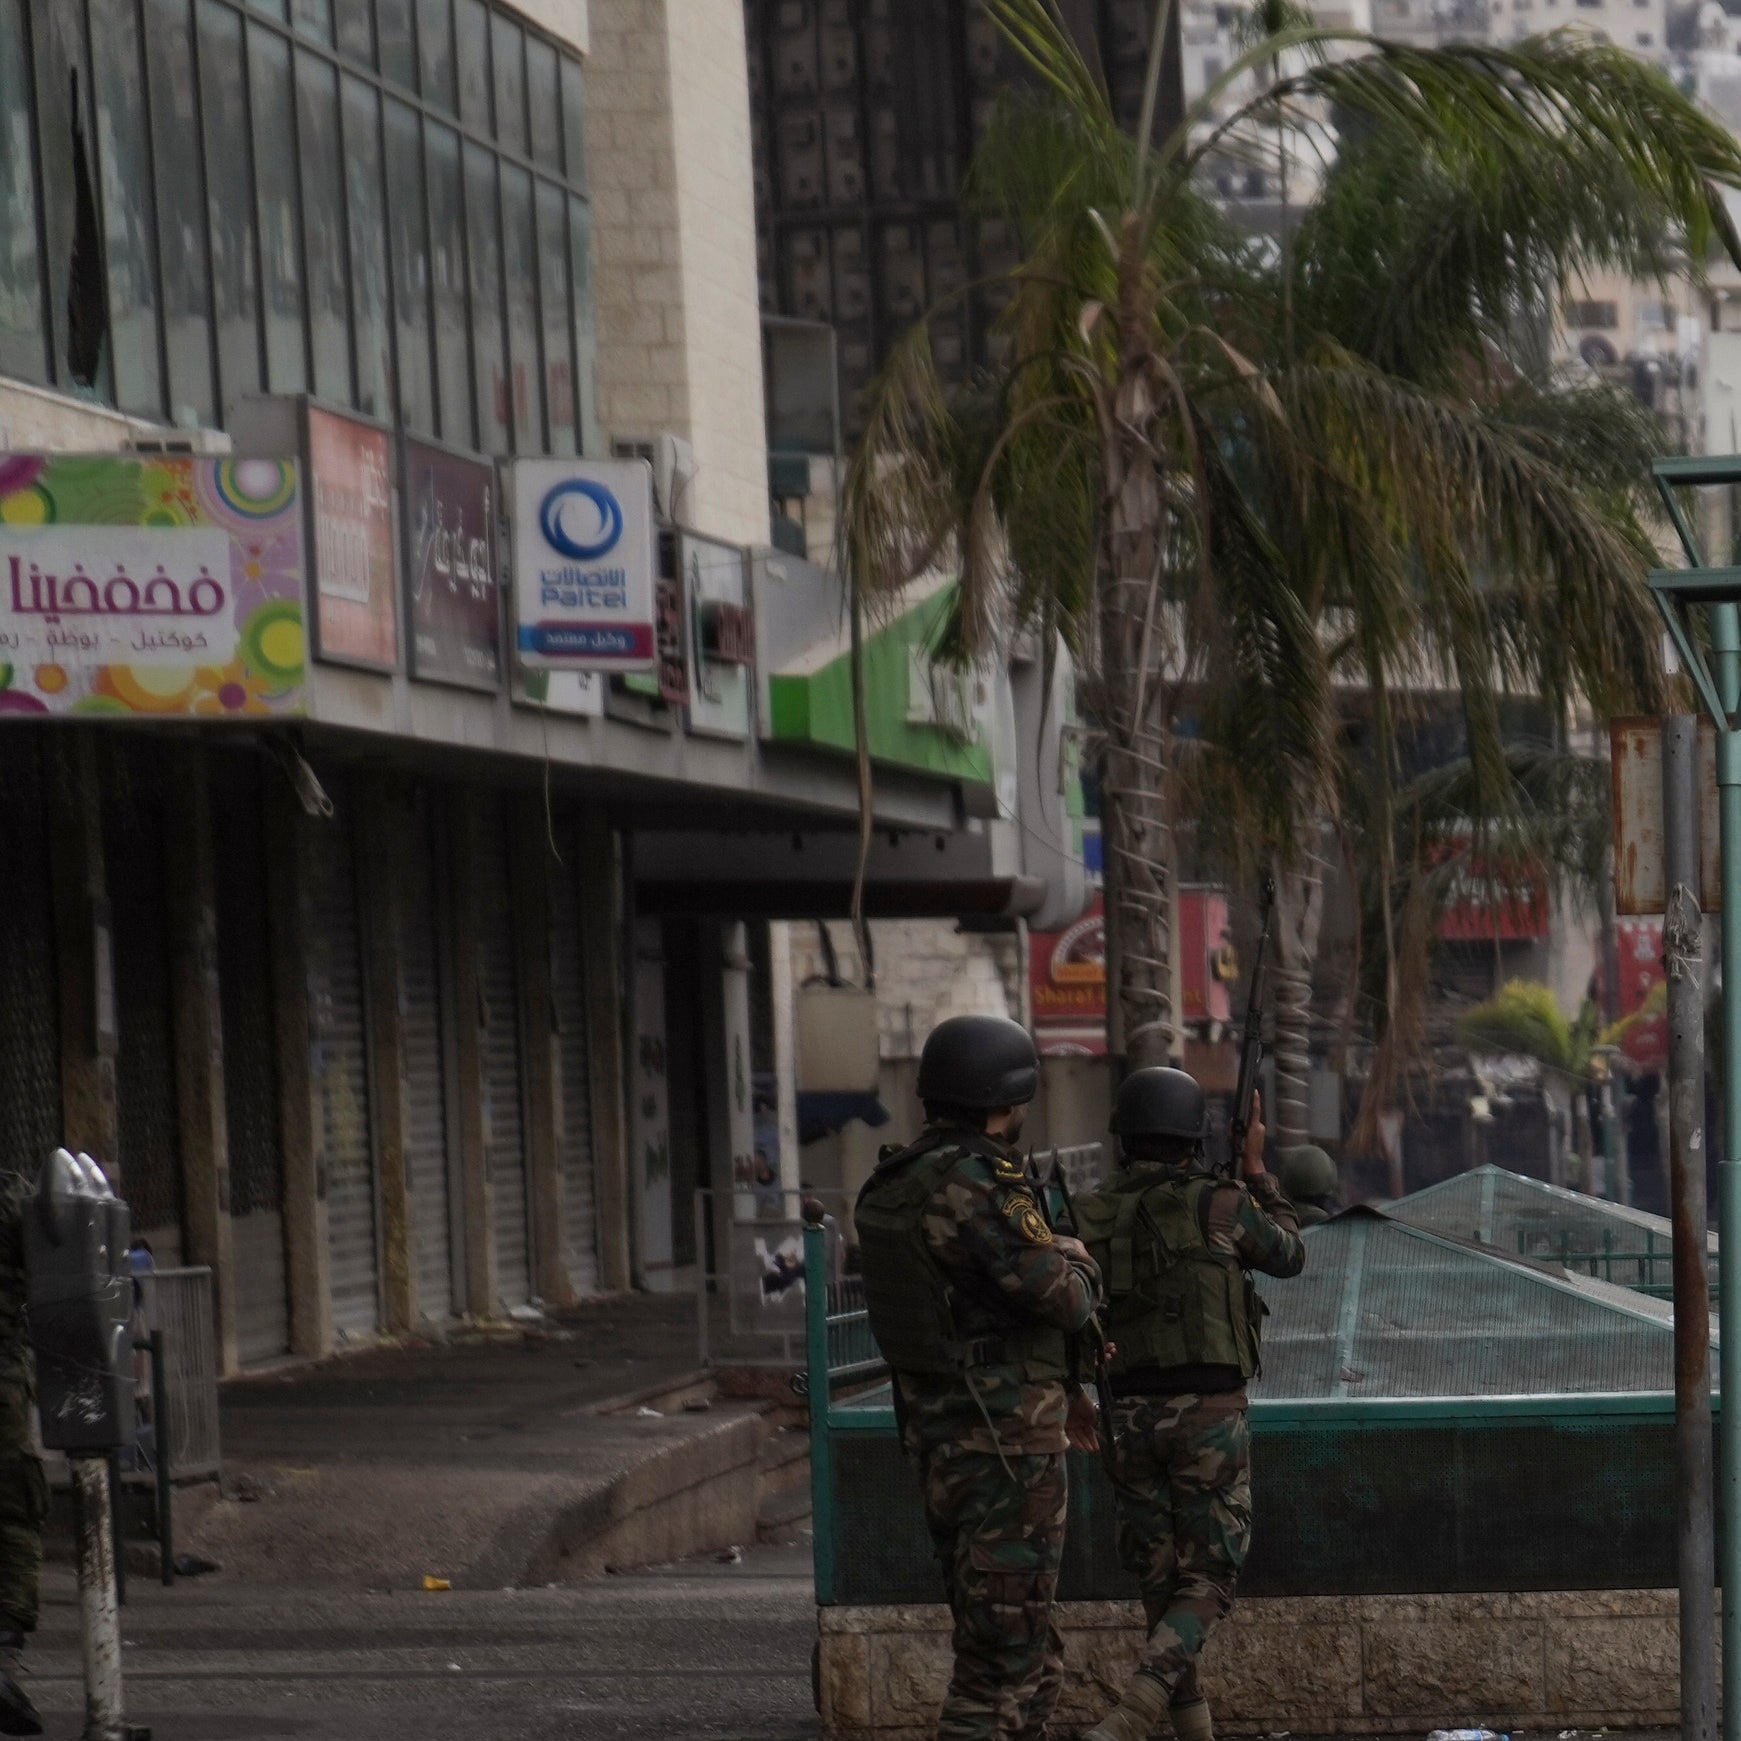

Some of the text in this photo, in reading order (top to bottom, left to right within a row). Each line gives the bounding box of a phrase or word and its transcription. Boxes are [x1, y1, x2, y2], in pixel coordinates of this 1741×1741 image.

[541, 567, 626, 586] الاتصالات
[8, 555, 225, 624] فخفخينا
[541, 586, 627, 608] Paltel
[131, 629, 208, 650] كوكتيل
[546, 631, 626, 649] وكيل معتمد
[1035, 985, 1094, 1006] Sharaf
